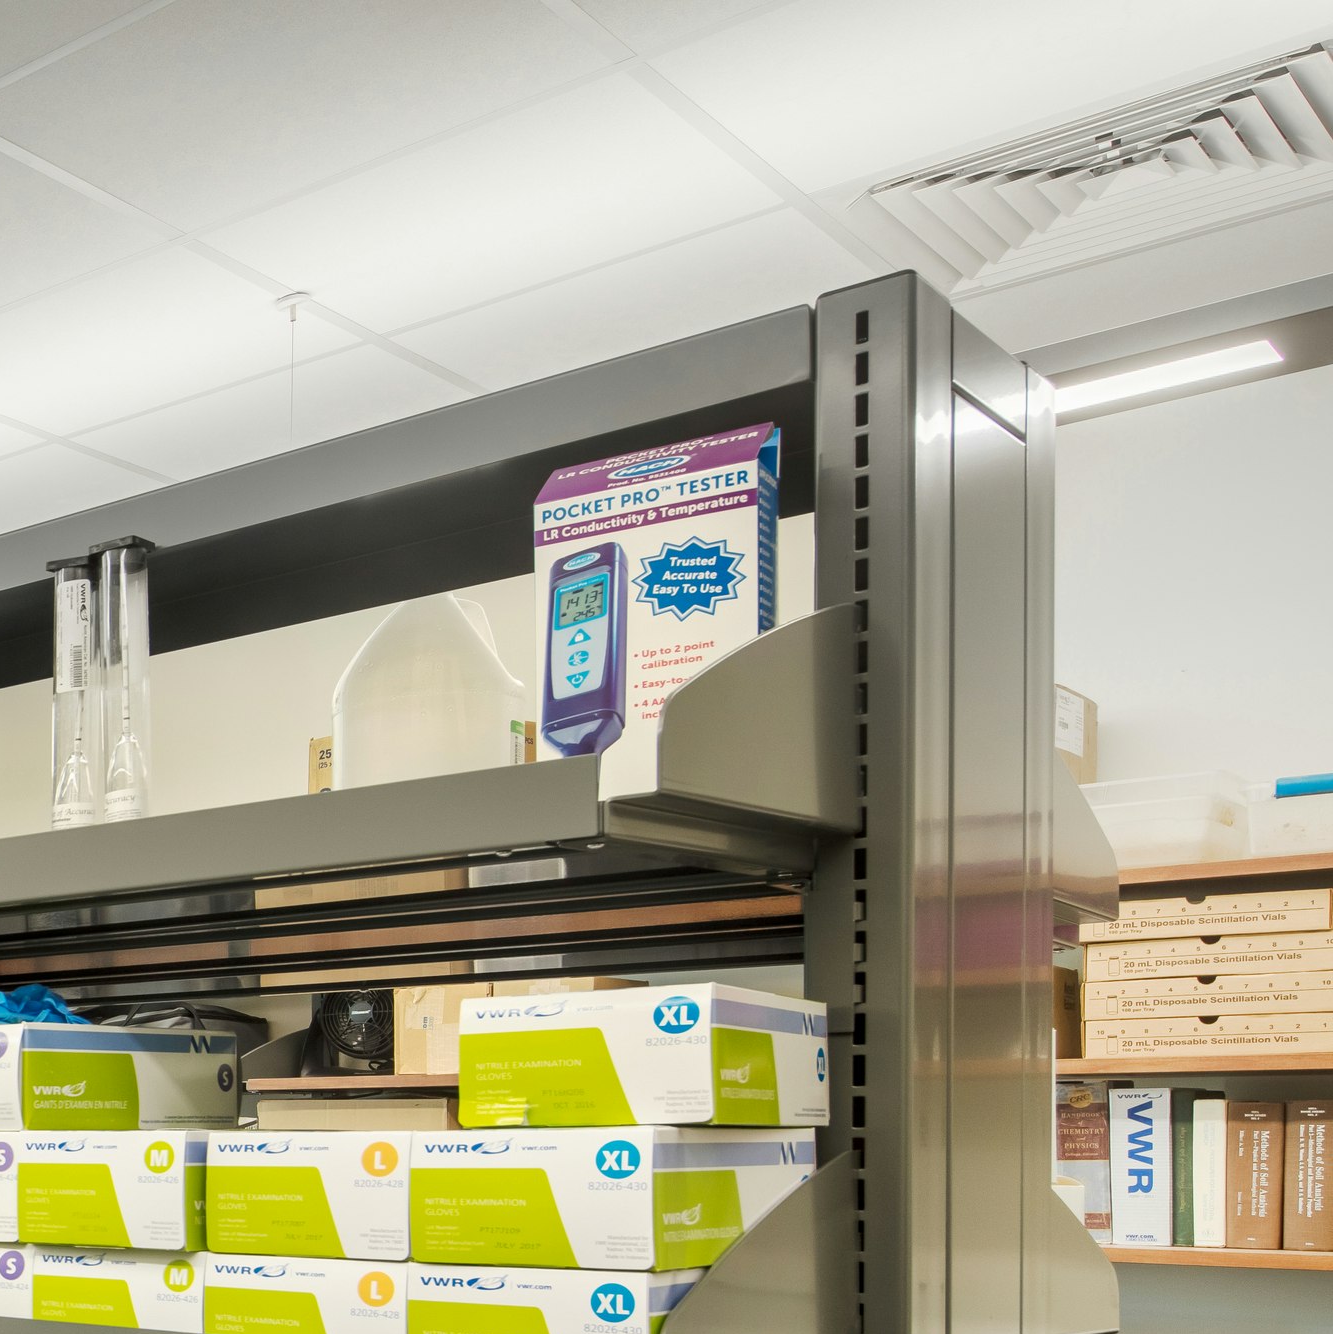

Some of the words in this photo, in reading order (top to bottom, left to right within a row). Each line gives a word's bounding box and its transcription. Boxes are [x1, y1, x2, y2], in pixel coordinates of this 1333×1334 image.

[557, 471, 576, 480] LR
[578, 444, 695, 477] CONDUCTIVITY
[695, 431, 759, 449] TESTER
[605, 447, 665, 465] POCKET
[617, 458, 680, 477] HACH
[607, 479, 631, 489] Prod.
[631, 477, 646, 485] No.
[541, 497, 616, 524] POCKET
[620, 484, 672, 509] PRO™
[675, 470, 750, 497] TESTER
[542, 527, 559, 542] LR
[561, 513, 646, 538] Conductivity
[647, 508, 657, 521] &
[659, 495, 749, 518] Temperature
[669, 556, 718, 568] Trusted
[662, 571, 718, 581] Accurate
[652, 584, 680, 597] Easy
[682, 584, 698, 594] To
[699, 583, 724, 594] Use
[642, 650, 657, 660] Up
[660, 648, 672, 656] to
[674, 645, 682, 653] 2
[684, 640, 715, 655] point
[641, 655, 703, 670] calibration
[641, 700, 649, 708] 4
[319, 748, 332, 761] 25
[1140, 918, 1195, 929] Disposable
[1199, 915, 1258, 925] Scintillation
[1262, 913, 1286, 921] Vials
[1155, 957, 1210, 968] Disposable
[1213, 954, 1273, 964] Scintillation
[1276, 952, 1302, 960] Vials
[1153, 997, 1208, 1007] Disposable
[1210, 995, 1270, 1004] Scintillation
[1273, 993, 1298, 1001] Vials
[476, 1007, 521, 1020] VWR
[658, 1004, 695, 1027] XL
[645, 1035, 708, 1047] 82026-430
[1153, 1038, 1208, 1047] Disposable
[1210, 1036, 1270, 1045] Scintillation
[1273, 1035, 1299, 1043] Vials
[222, 1071, 229, 1086] S
[33, 1085, 62, 1096] VWR
[34, 1101, 58, 1110] GANTS
[91, 1100, 103, 1109] EN
[1069, 1093, 1090, 1103] CRC
[26, 1142, 57, 1151] VWR
[1260, 1130, 1270, 1159] Methods
[1315, 1124, 1326, 1155] Methods
[218, 1144, 255, 1153] VWR
[425, 1144, 468, 1154] VWR
[521, 1144, 558, 1152] vwr.com
[1127, 1100, 1153, 1194] VWR
[149, 1149, 169, 1167] M
[374, 1151, 386, 1170] L
[600, 1150, 636, 1171] XL
[1316, 1157, 1325, 1165] of
[1260, 1163, 1269, 1171] of
[1315, 1166, 1325, 1180] Soil
[354, 1179, 404, 1188] 82026-428
[587, 1181, 648, 1191] 82026-430
[1259, 1172, 1269, 1187] Soil
[1259, 1188, 1269, 1218] Analysis
[1314, 1182, 1325, 1212] Analysis
[5, 1256, 17, 1276] S
[42, 1254, 74, 1265] VWR
[168, 1267, 189, 1286] M
[214, 1265, 251, 1275] VWR
[420, 1276, 464, 1287] VWR
[370, 1281, 382, 1300] L
[596, 1293, 630, 1315] XL
[350, 1308, 401, 1319] 82026-428
